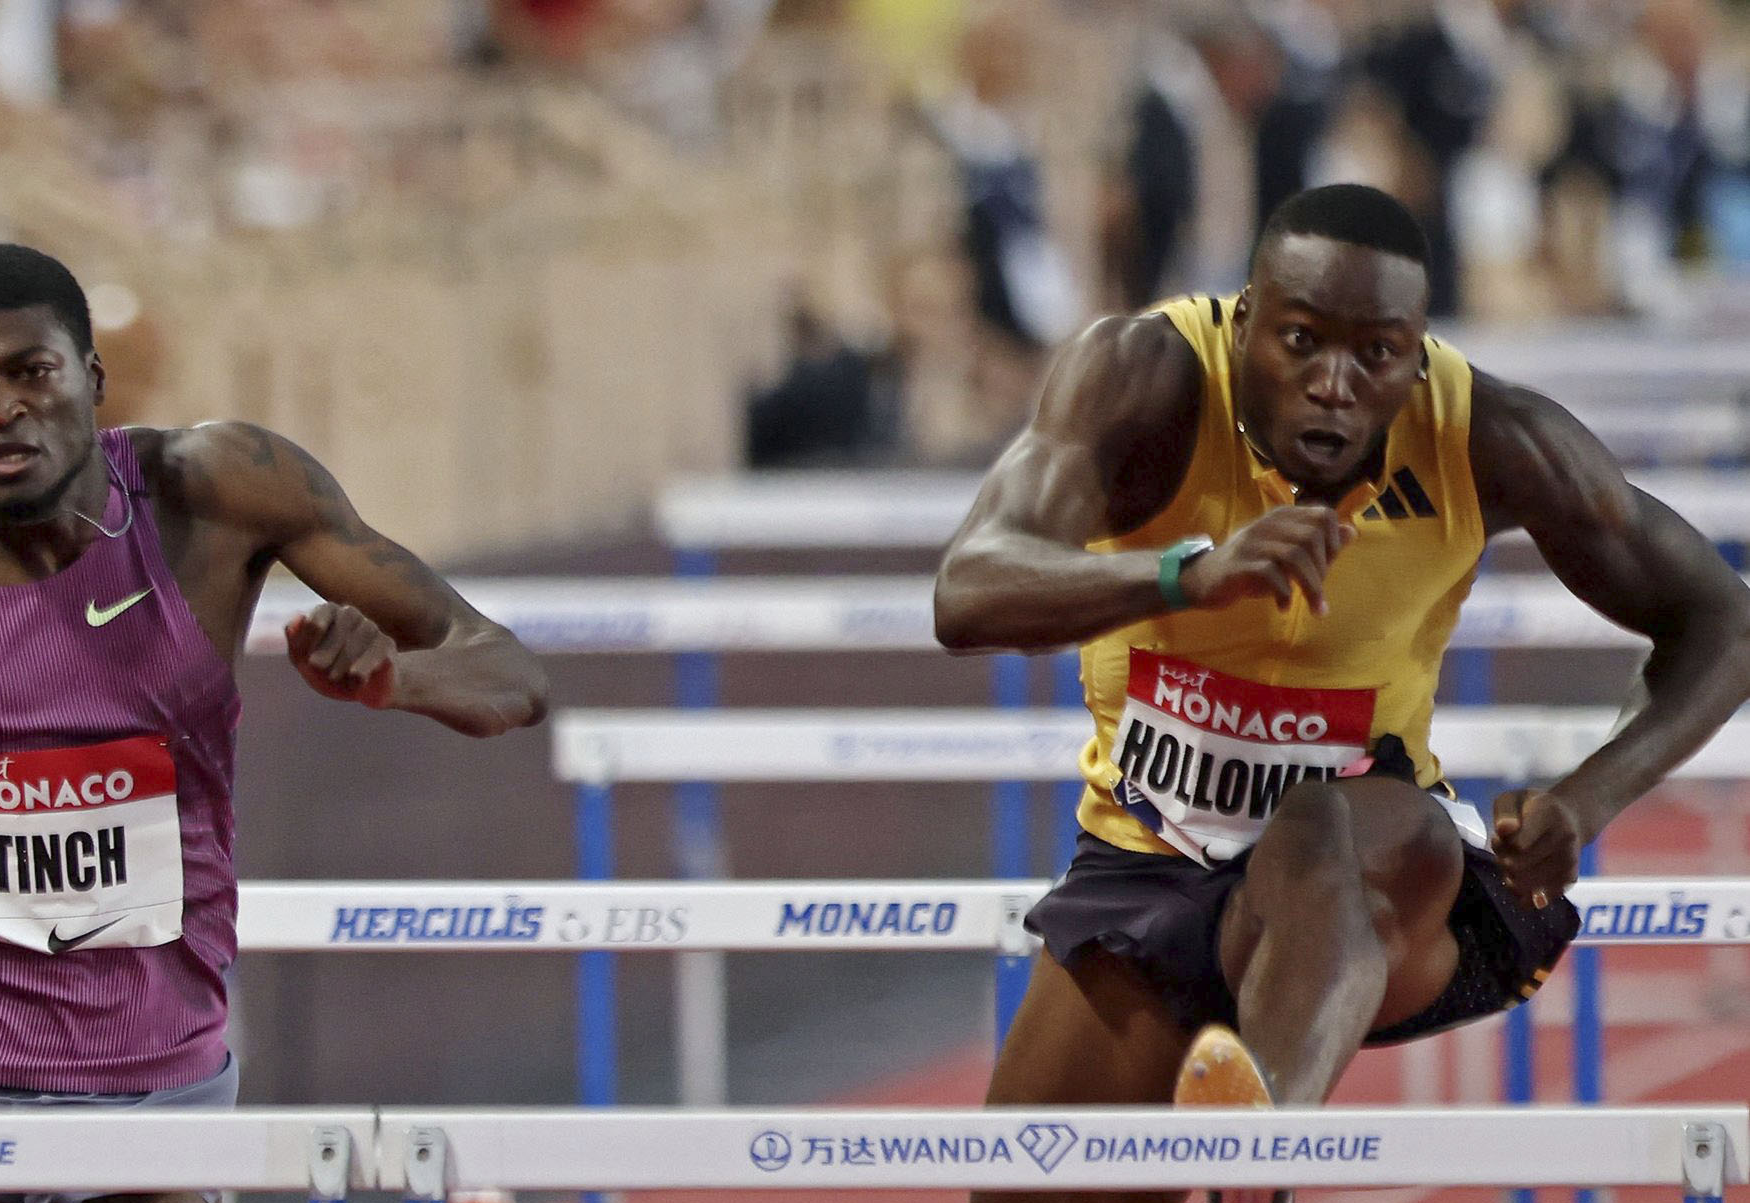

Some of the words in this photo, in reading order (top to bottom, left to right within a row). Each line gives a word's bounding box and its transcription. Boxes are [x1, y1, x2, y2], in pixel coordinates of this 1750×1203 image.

[1154, 677, 1328, 741] MONACO
[1119, 718, 1337, 820] HOLLOW
[329, 905, 544, 943] HERCULIS
[601, 906, 688, 943] EBS
[776, 902, 958, 936] MONACO
[1575, 903, 1710, 936] CULIS
[880, 1136, 1014, 1163] WANDA
[1084, 1136, 1242, 1162] DIAMOND
[1251, 1136, 1381, 1161] LEAGUE
